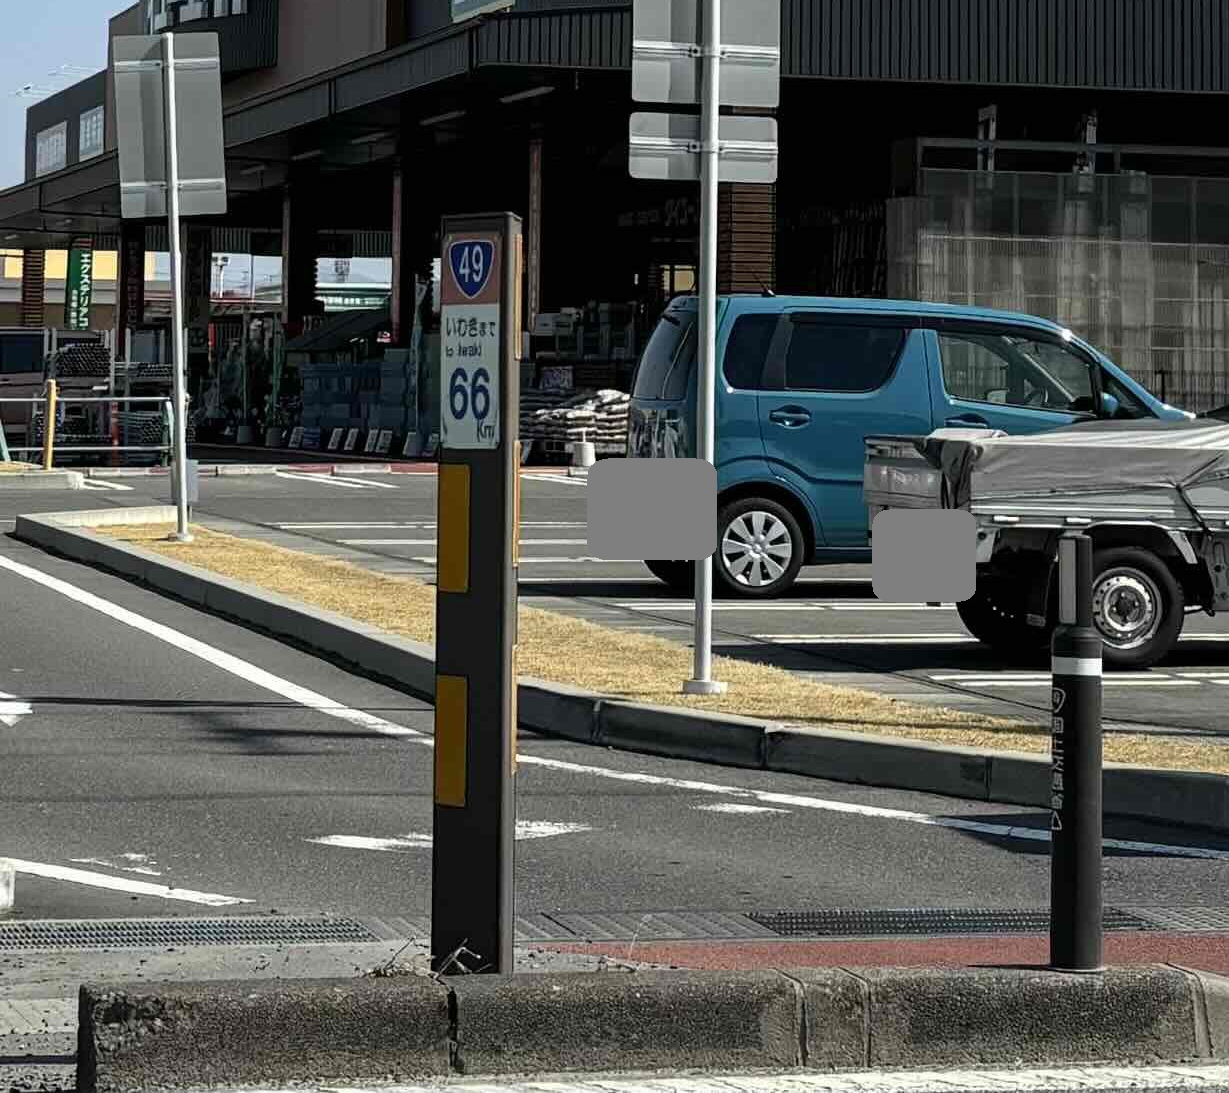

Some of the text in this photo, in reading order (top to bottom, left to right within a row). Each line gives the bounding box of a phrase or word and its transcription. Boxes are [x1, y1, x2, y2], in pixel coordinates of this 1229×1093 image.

[459, 245, 484, 283] 49
[79, 253, 91, 330] エクステリアコ
[446, 317, 496, 337] いわきまで
[450, 367, 490, 420] 66
